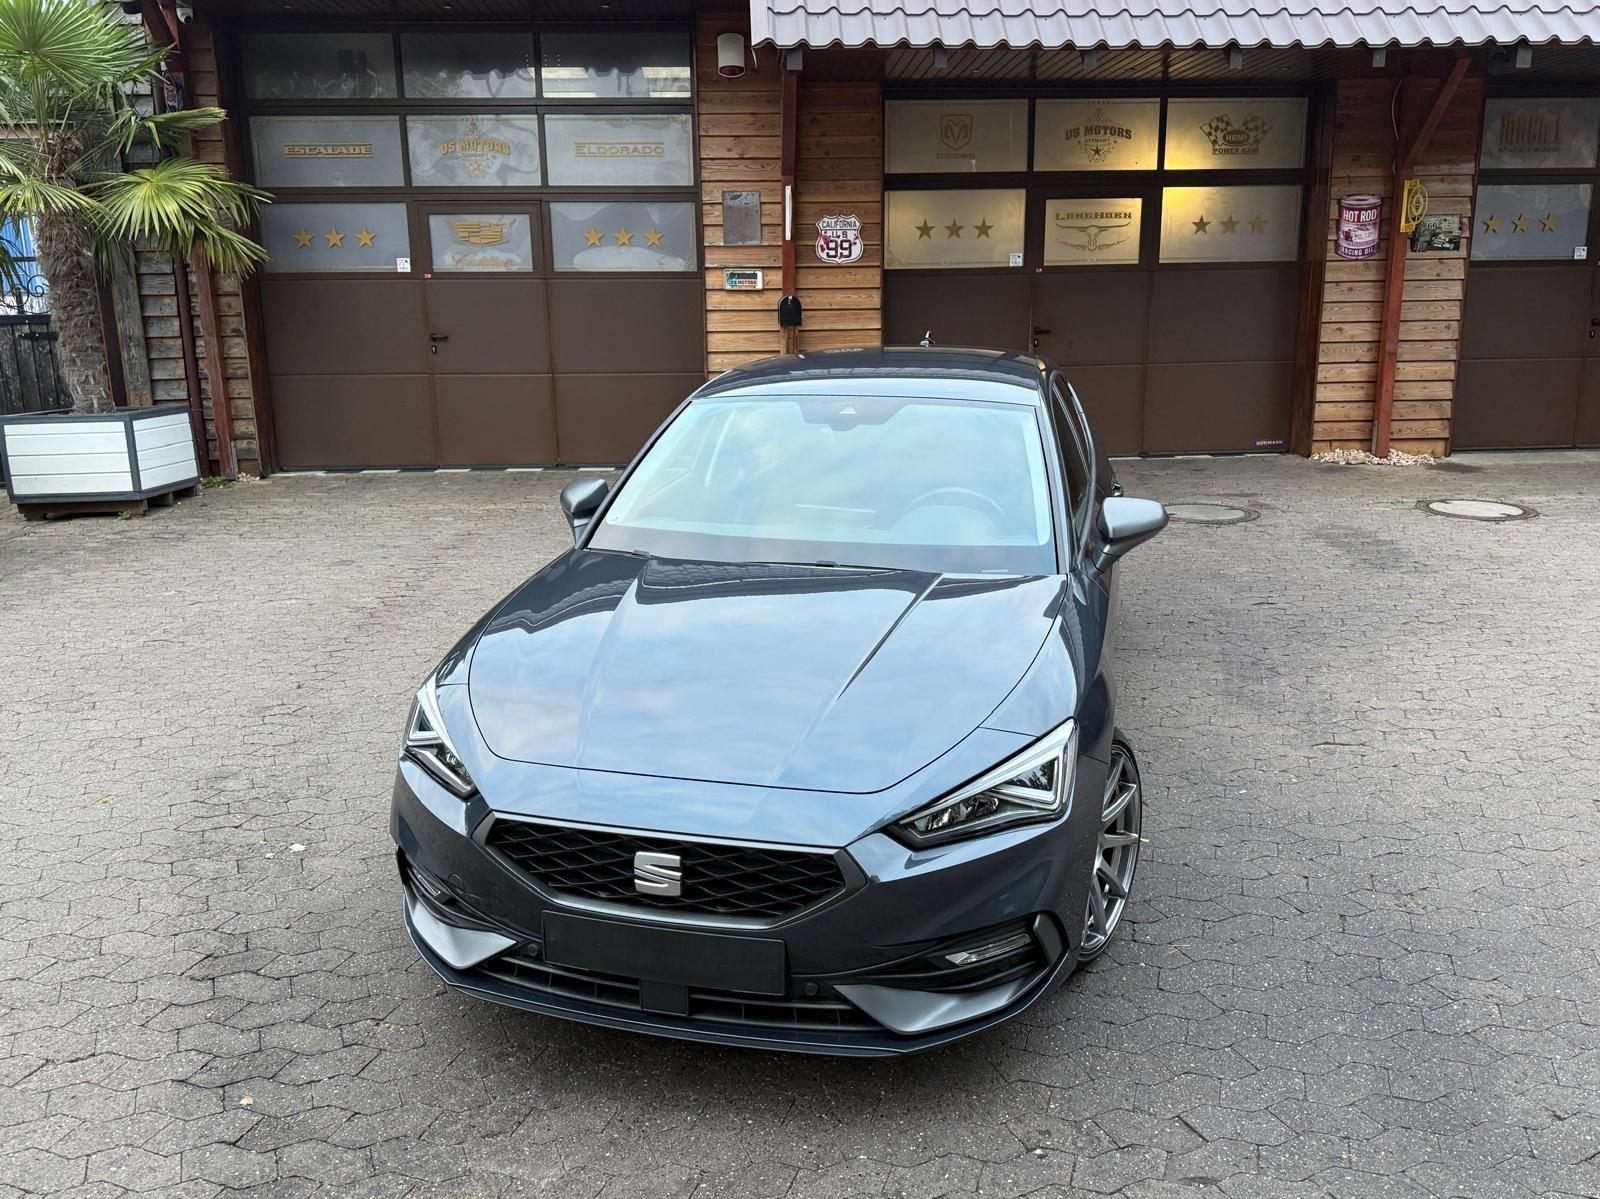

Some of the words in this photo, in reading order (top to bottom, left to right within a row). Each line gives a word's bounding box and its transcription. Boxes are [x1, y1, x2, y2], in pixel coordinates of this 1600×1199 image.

[1065, 127, 1080, 140] US
[1084, 125, 1132, 139] MOTORS
[1225, 133, 1248, 142] HEMI
[283, 145, 371, 155] ESCALADE
[440, 142, 456, 155] US
[459, 139, 511, 155] MOTORS
[575, 145, 665, 155] ELDORADO
[936, 152, 976, 160] DODGE
[1056, 212, 1132, 220] LONGHORN
[1343, 209, 1360, 222] HOT
[1360, 209, 1377, 222] ROD
[822, 220, 857, 228] CALIFORNIA
[826, 239, 852, 258] 99
[1341, 246, 1363, 256] RACING
[1364, 247, 1374, 255] OIL
